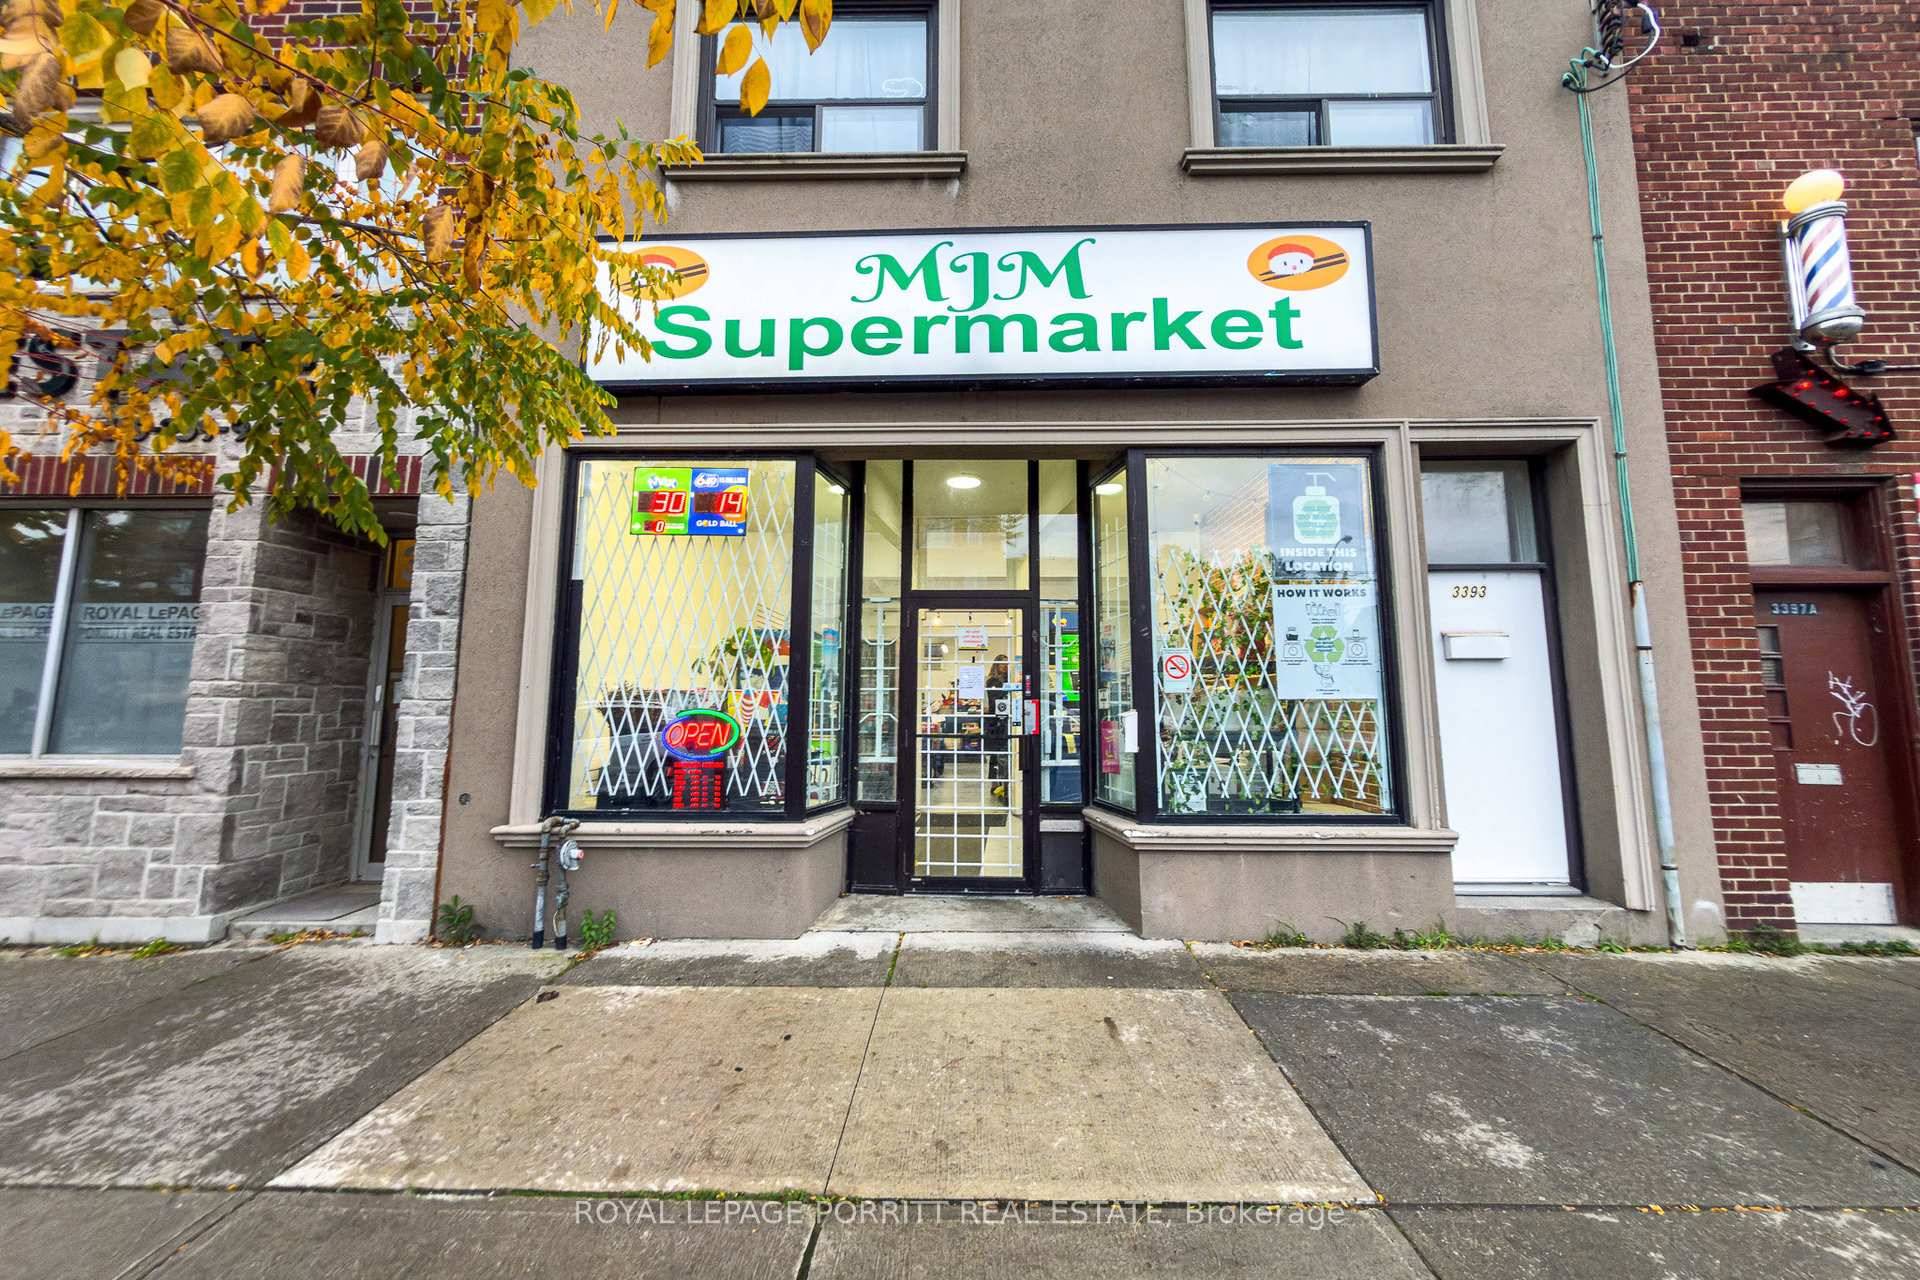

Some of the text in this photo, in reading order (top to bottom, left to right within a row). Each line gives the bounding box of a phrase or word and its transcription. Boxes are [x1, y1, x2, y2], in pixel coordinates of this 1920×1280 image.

[851, 238, 1095, 312] MJM
[651, 296, 1304, 371] Supermarket
[653, 491, 686, 513] 30
[719, 493, 743, 513] 14
[1280, 547, 1357, 557] INSIDE THIS
[1285, 561, 1353, 571] LOCATION
[1277, 588, 1366, 598] HOW IT WORKS
[1452, 585, 1487, 598] 3393
[83, 605, 143, 620] ROYAL
[666, 722, 731, 746] OPEN
